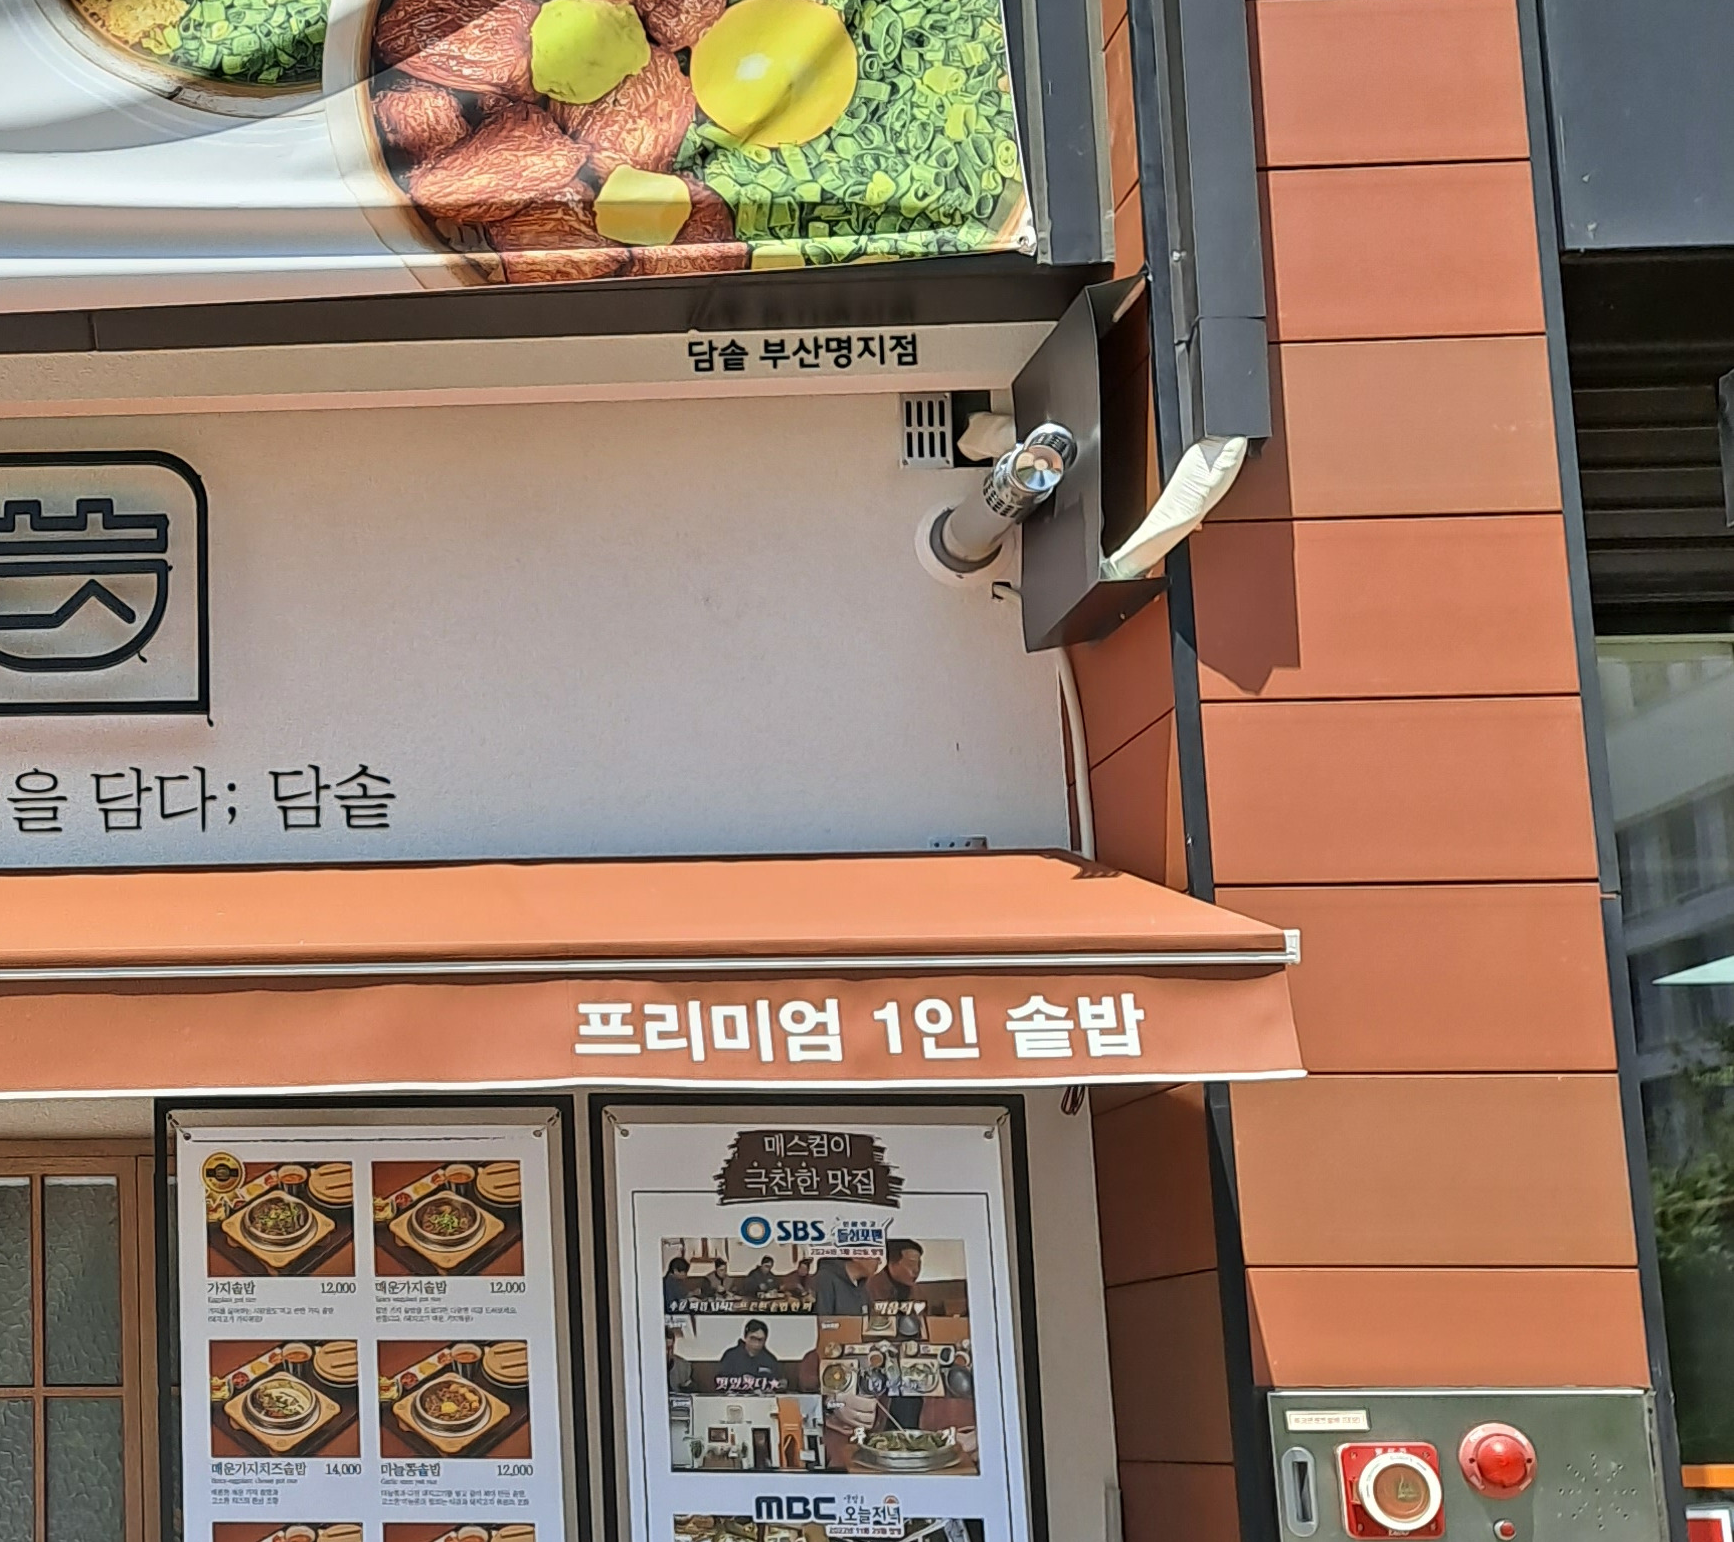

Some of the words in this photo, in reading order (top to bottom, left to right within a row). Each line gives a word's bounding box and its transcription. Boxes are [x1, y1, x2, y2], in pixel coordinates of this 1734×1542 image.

[687, 338, 750, 373] 담솥
[759, 333, 919, 370] 부산명지점
[91, 764, 241, 833] 담다;
[269, 762, 398, 831] 담솥
[574, 997, 844, 1063] 프리미엄
[872, 995, 981, 1060] 1인
[1004, 992, 1145, 1059] 솥밥
[763, 1133, 853, 1158] 매스컴이
[742, 1165, 821, 1196] 극찬한
[827, 1168, 876, 1196] 맛집
[776, 1220, 826, 1242] SBS
[754, 1495, 838, 1521] MBC
